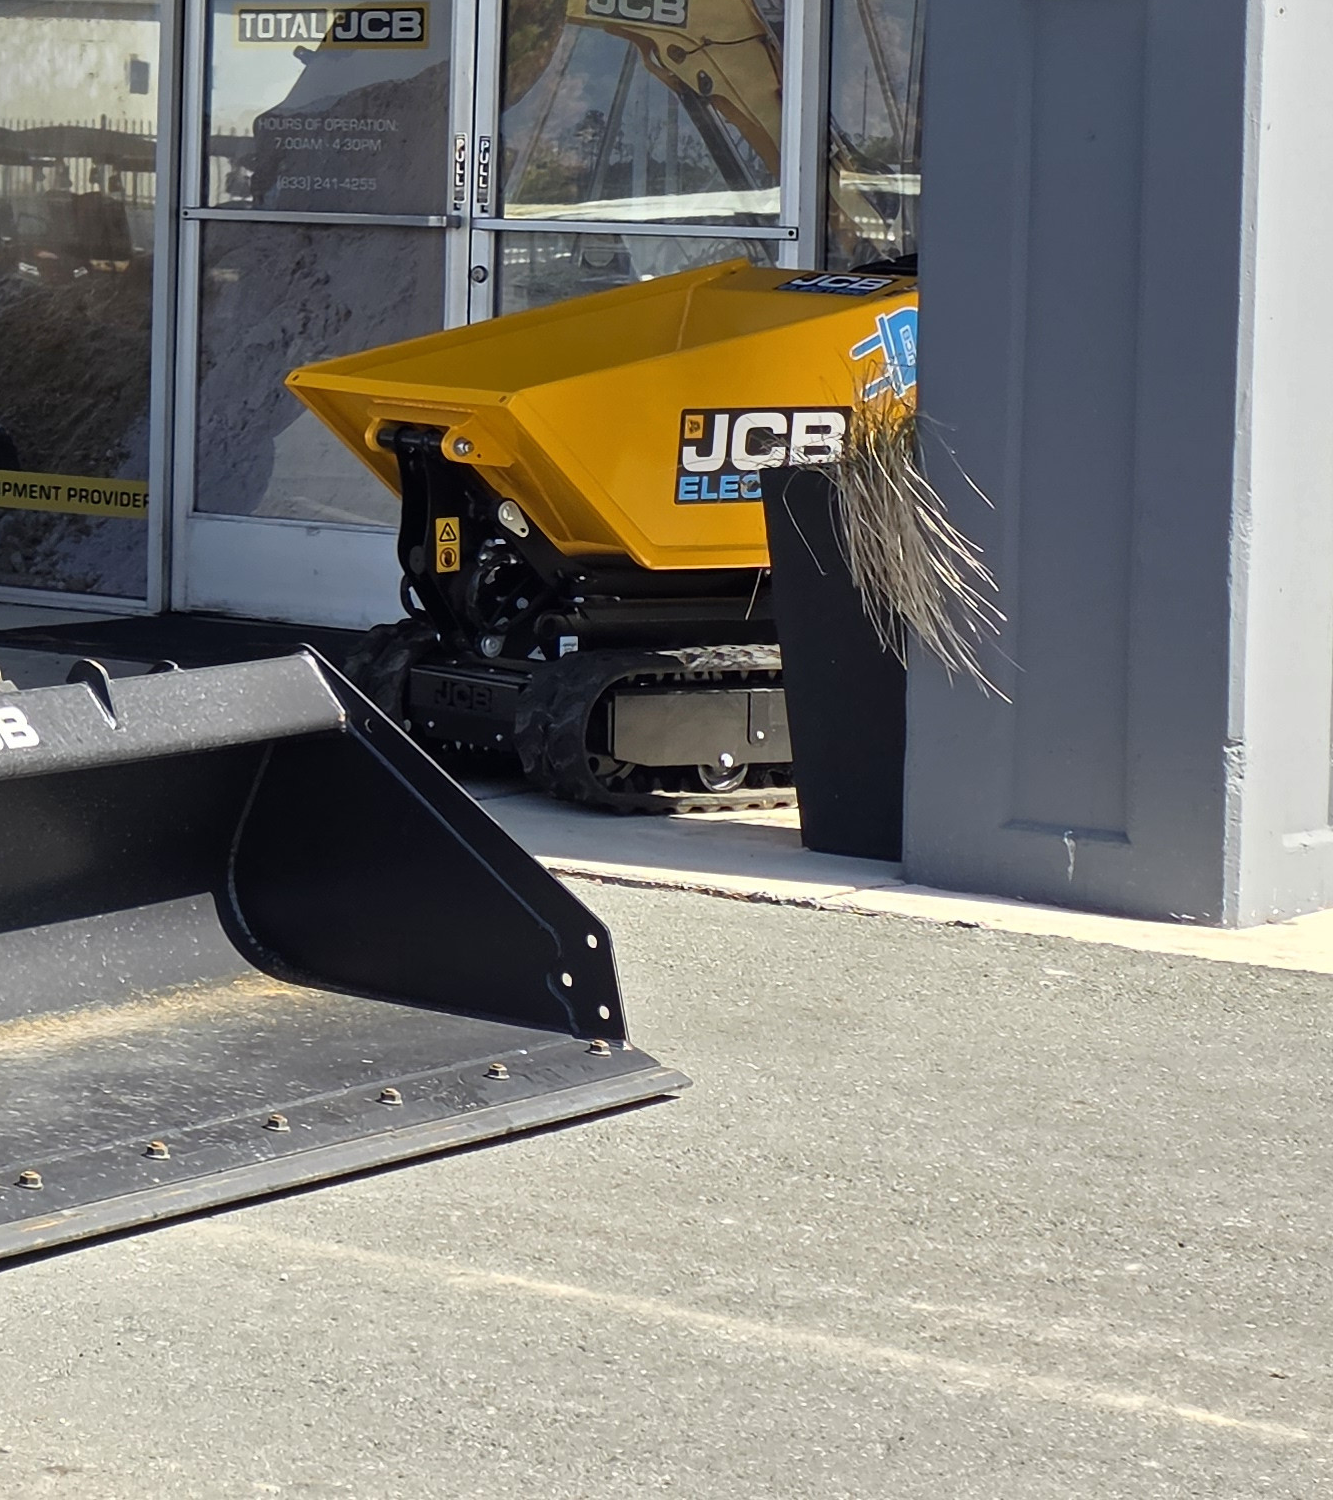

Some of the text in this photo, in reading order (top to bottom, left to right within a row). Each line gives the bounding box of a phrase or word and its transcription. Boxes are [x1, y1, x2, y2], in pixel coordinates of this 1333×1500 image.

[241, 11, 423, 40] TOTAL JCB
[258, 118, 302, 131] HOURS
[305, 119, 322, 131] OF
[455, 139, 465, 186] PULL
[479, 140, 490, 188] PULL
[791, 274, 893, 290] JCB
[682, 412, 846, 472] JCB
[678, 474, 762, 500] ELEC
